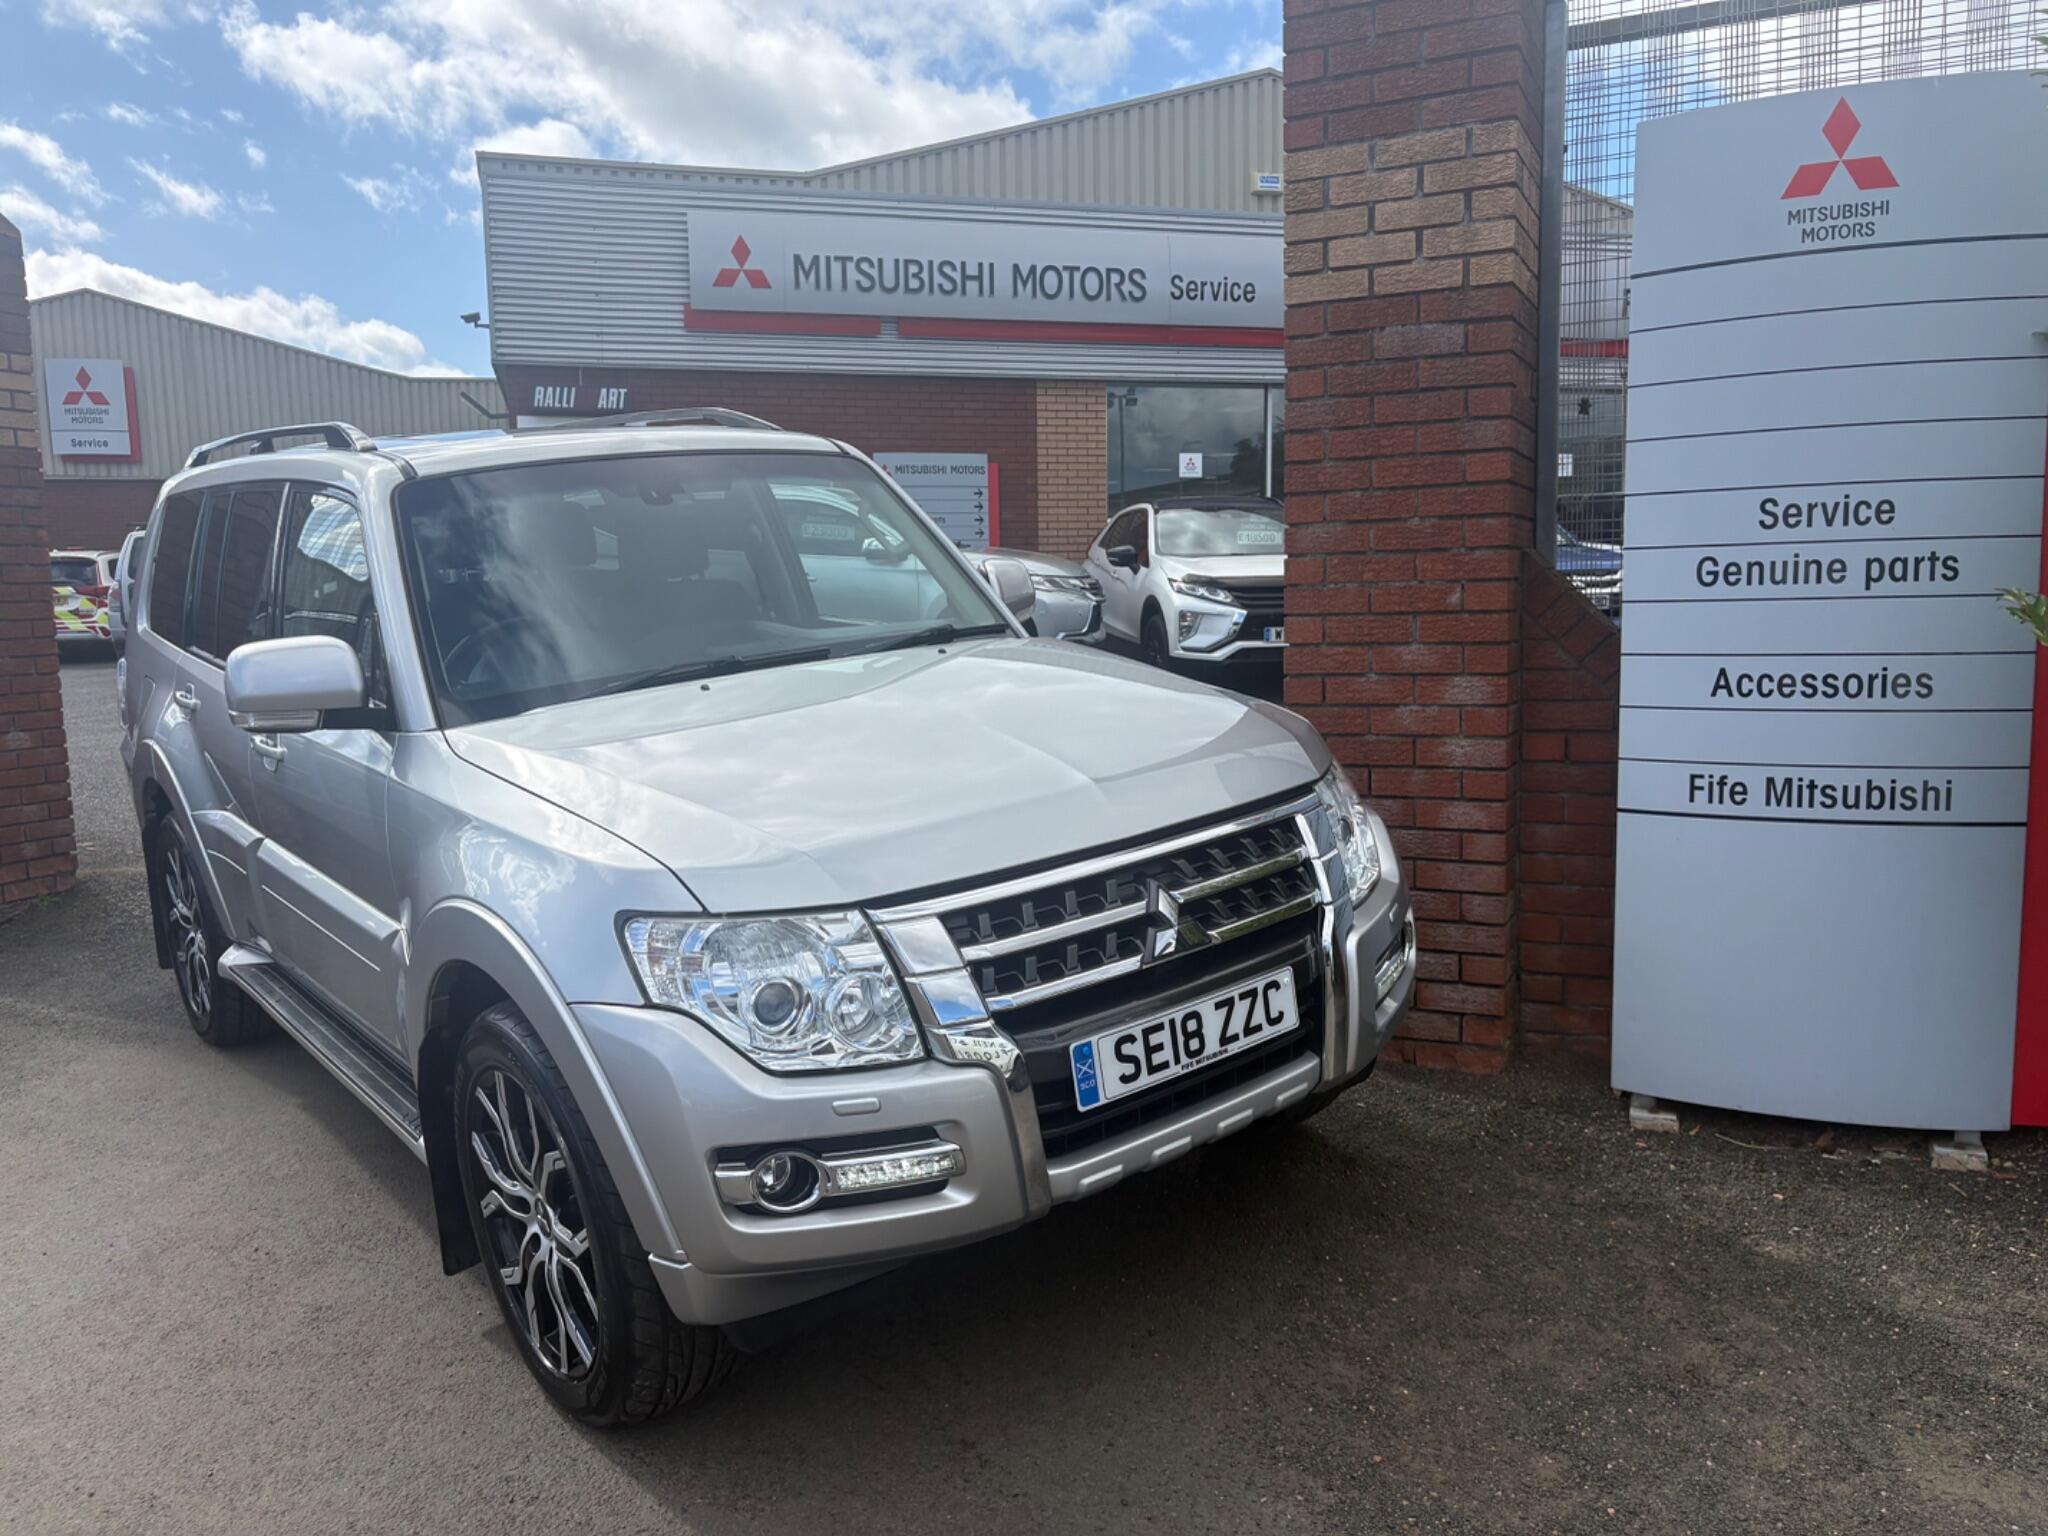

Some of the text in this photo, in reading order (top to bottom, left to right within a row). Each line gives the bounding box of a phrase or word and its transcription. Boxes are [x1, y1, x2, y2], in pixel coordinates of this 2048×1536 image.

[1787, 199, 1890, 226] MITSUBISHI
[1801, 221, 1876, 244] MOTORS
[793, 253, 1256, 304] MITSUBISHI MOTORS Service
[533, 385, 628, 410] RALLI ART
[63, 406, 110, 417] MITSUBISHI
[71, 416, 104, 425] MOTORS
[71, 437, 109, 449] Service
[894, 463, 986, 476] MITSUBISHI MOTORS
[1758, 494, 1896, 531] Service
[1695, 550, 1960, 591] Genuine parts
[1710, 666, 1934, 699] Accessories
[1688, 773, 1953, 812] Fife Mitsubishi
[1114, 980, 1284, 1085] SE18 ZZC
